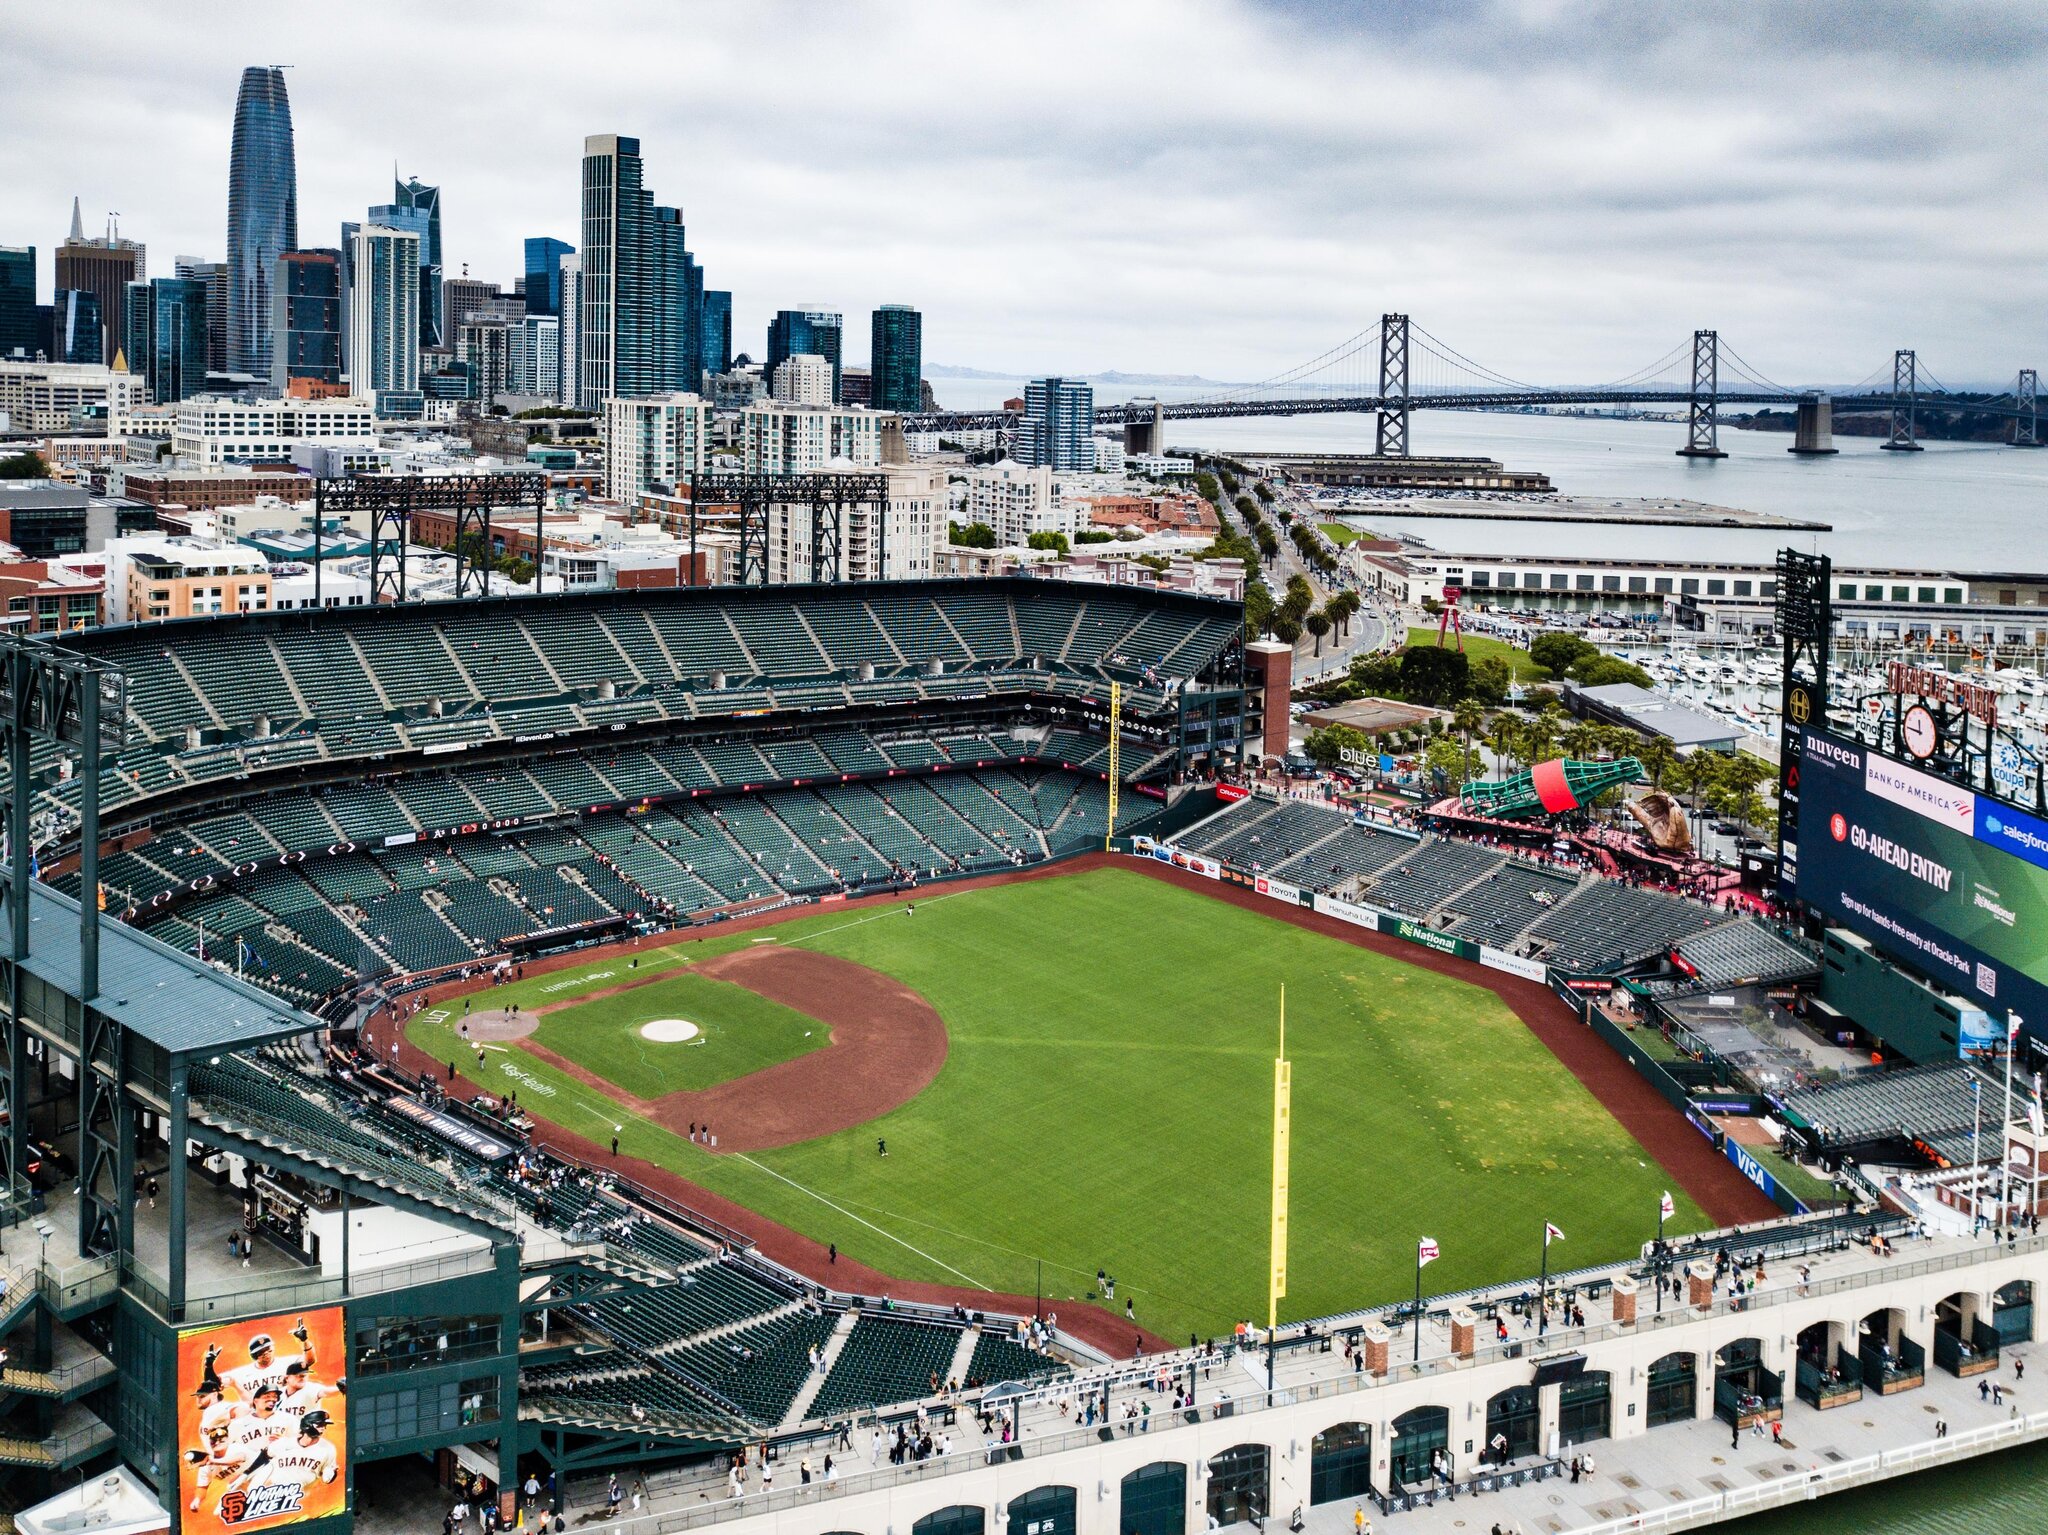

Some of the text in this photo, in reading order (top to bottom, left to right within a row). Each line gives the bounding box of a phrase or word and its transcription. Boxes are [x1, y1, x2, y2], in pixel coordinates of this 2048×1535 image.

[1888, 661, 1999, 729] ORACLE PARK
[1340, 745, 1377, 767] blue
[1806, 735, 1860, 770] nuveen
[1868, 768, 1951, 811] BANK OF AMERICA
[1993, 766, 2025, 791] coupa
[2003, 824, 2048, 853] salesforc
[1851, 824, 1952, 892] GO-AHEAD ENTRY
[1270, 886, 1297, 899] TOYOTA
[1328, 904, 1375, 925] Hanwha Life
[1983, 896, 2016, 921] National
[1412, 927, 1456, 949] National
[1841, 891, 1970, 975] Sign up for hands-free entry at Oracle Park
[1481, 954, 1497, 962] BANK
[1505, 961, 1532, 974] AMERICA
[455, 1131, 481, 1146] PARK
[1735, 1146, 1765, 1191] VISA
[241, 1426, 286, 1444] GIANTS
[278, 1457, 321, 1471] GIANTS
[221, 1483, 302, 1523] SF NOTHING
[245, 1491, 303, 1518] LIKE IT
